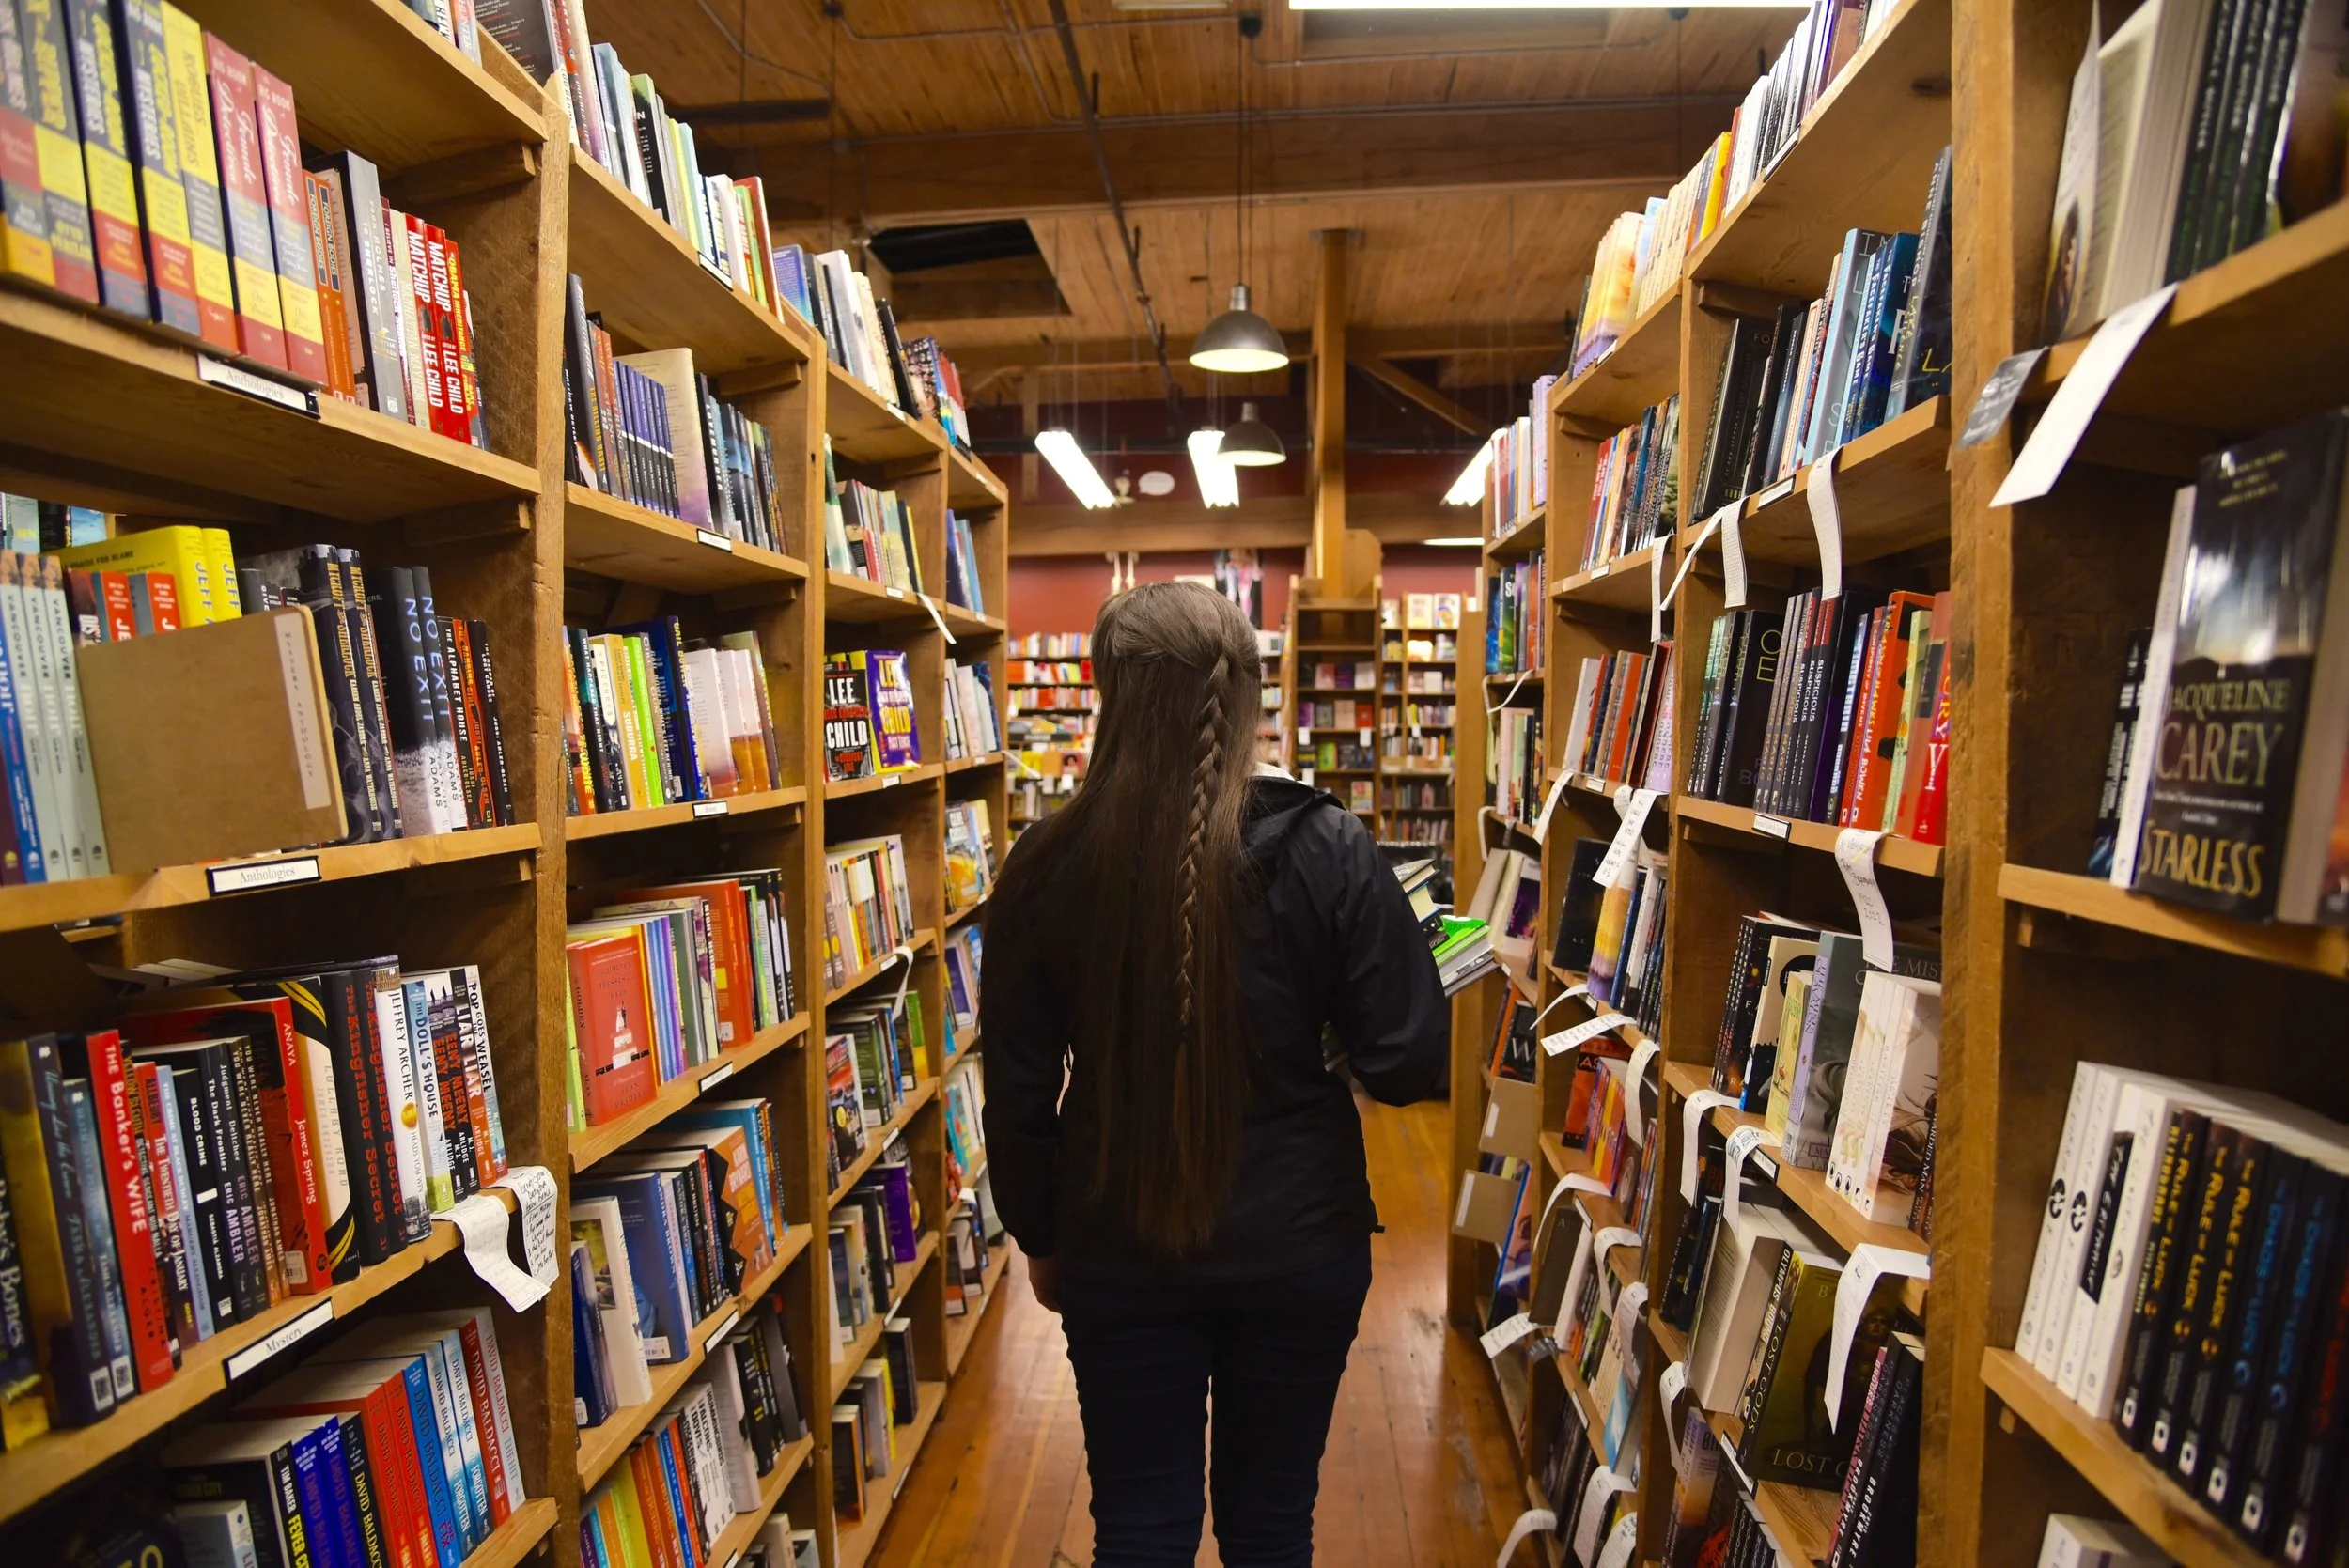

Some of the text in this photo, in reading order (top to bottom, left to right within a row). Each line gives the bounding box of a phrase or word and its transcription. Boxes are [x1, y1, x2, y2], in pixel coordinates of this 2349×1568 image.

[322, 201, 334, 242] FOREIGN
[1910, 162, 1939, 287] ANNE BISHOP
[408, 230, 431, 303] MATCHUP
[428, 241, 452, 312] MATCHUP
[448, 256, 460, 300] OBAMA
[1904, 295, 1920, 340] LAKE
[226, 367, 286, 400] Anthologies
[423, 342, 443, 409] LEE CHILD
[443, 349, 465, 414] LEE CHILD
[194, 562, 213, 609] JEFF
[223, 564, 240, 609] JEFF
[30, 597, 50, 679] VANCOUVER
[52, 598, 71, 680] VANCOUVER
[327, 562, 357, 679] MYCROFT SHERLOCK
[350, 566, 366, 610] MYCROFT
[360, 624, 378, 679] SHERLOCK
[581, 637, 590, 660] WHAT
[405, 598, 434, 720] NO EXIT
[422, 596, 450, 715] NO EXIT
[284, 632, 313, 778] MYSTERY ANTHOLOGY
[446, 645, 462, 703] ALPHABET
[456, 706, 468, 742] HOUSE
[592, 706, 600, 726] THAT
[829, 677, 856, 706] LEE
[879, 706, 911, 736] CHILD
[1791, 661, 1806, 724] SUSPICIOUS
[1800, 660, 1815, 722] SUSPICIOUS
[1809, 659, 1825, 722] SUSPICIOUS
[594, 728, 604, 753] NIGHT
[623, 710, 639, 762] SUBURRA
[826, 720, 868, 750] CHILD
[2156, 721, 2285, 787] CAREY
[428, 755, 443, 808] ADAMS
[445, 751, 459, 801] ADAMS
[1856, 757, 1870, 801] BOWEN
[240, 862, 297, 885] Anthologies
[2139, 819, 2266, 899] STARLESS
[468, 982, 480, 1010] POP
[475, 1011, 486, 1039] GOES
[283, 1021, 297, 1067] ANAYA
[388, 992, 414, 1102] JEFFREY ARCHER
[415, 1002, 440, 1118] THE DOLL'S HOUSE
[456, 1003, 482, 1099] LIAR LIAR
[476, 1040, 492, 1094] WEASEL
[219, 1063, 233, 1110] Judgment
[344, 984, 387, 1223] The Kingfisher Secret
[365, 981, 405, 1216] The Kingfisher Secret
[433, 1037, 457, 1131] EENY MEENY
[445, 1032, 470, 1125] EENY MEENY
[104, 1045, 147, 1234] THE Banker's WIFE
[190, 1097, 207, 1167] BLOOD CRIME
[208, 1078, 228, 1172] The Dark Frontier
[244, 1044, 273, 1184] YOU WERE NEVER REALLY HERE
[410, 1131, 419, 1157] HEADS
[459, 1131, 470, 1163] ARLIDGE
[294, 1118, 318, 1205] Jemez Spring
[335, 1147, 349, 1188] ROAD
[413, 1157, 422, 1174] YOU
[445, 1138, 456, 1172] ARLIDGE
[154, 1135, 188, 1291] THE TWENTIETH DAY OF JANUARY
[224, 1181, 245, 1264] ERIC AMBLER
[237, 1175, 260, 1265] ERIC AMBLER
[2182, 1172, 2225, 1312] RULE LUCK
[2210, 1185, 2252, 1330] RULE LUCK
[1762, 1249, 1791, 1345] OLYMPUS BOUND
[265, 1326, 303, 1356] Mystery
[452, 1358, 474, 1442] DAVID BALDACCI
[471, 1352, 502, 1474] DAVID BALDACCI
[486, 1333, 510, 1436] DAVID BALDACCI
[1748, 1325, 1782, 1435] LOST GODS
[434, 1373, 455, 1457] DAVID BALDACCI
[691, 1410, 702, 1450] DOVES
[698, 1401, 713, 1452] FALCONS
[707, 1390, 726, 1467] HUMMINGBIRDS
[396, 1405, 423, 1512] DAVID BALDACCI
[413, 1389, 447, 1517] DAVID BALDACCI
[1772, 1448, 1832, 1475] LOST
[280, 1464, 306, 1557] TIM BAKER FEVER
[354, 1471, 371, 1512] DAVID
[453, 1479, 471, 1534] FORGOTTEN
[471, 1465, 488, 1517] FORGOTTEN
[1837, 1456, 1864, 1539] BROOKMYRE
[1848, 1476, 1877, 1560] BROOKMYRE
[439, 1521, 451, 1551] FIX
